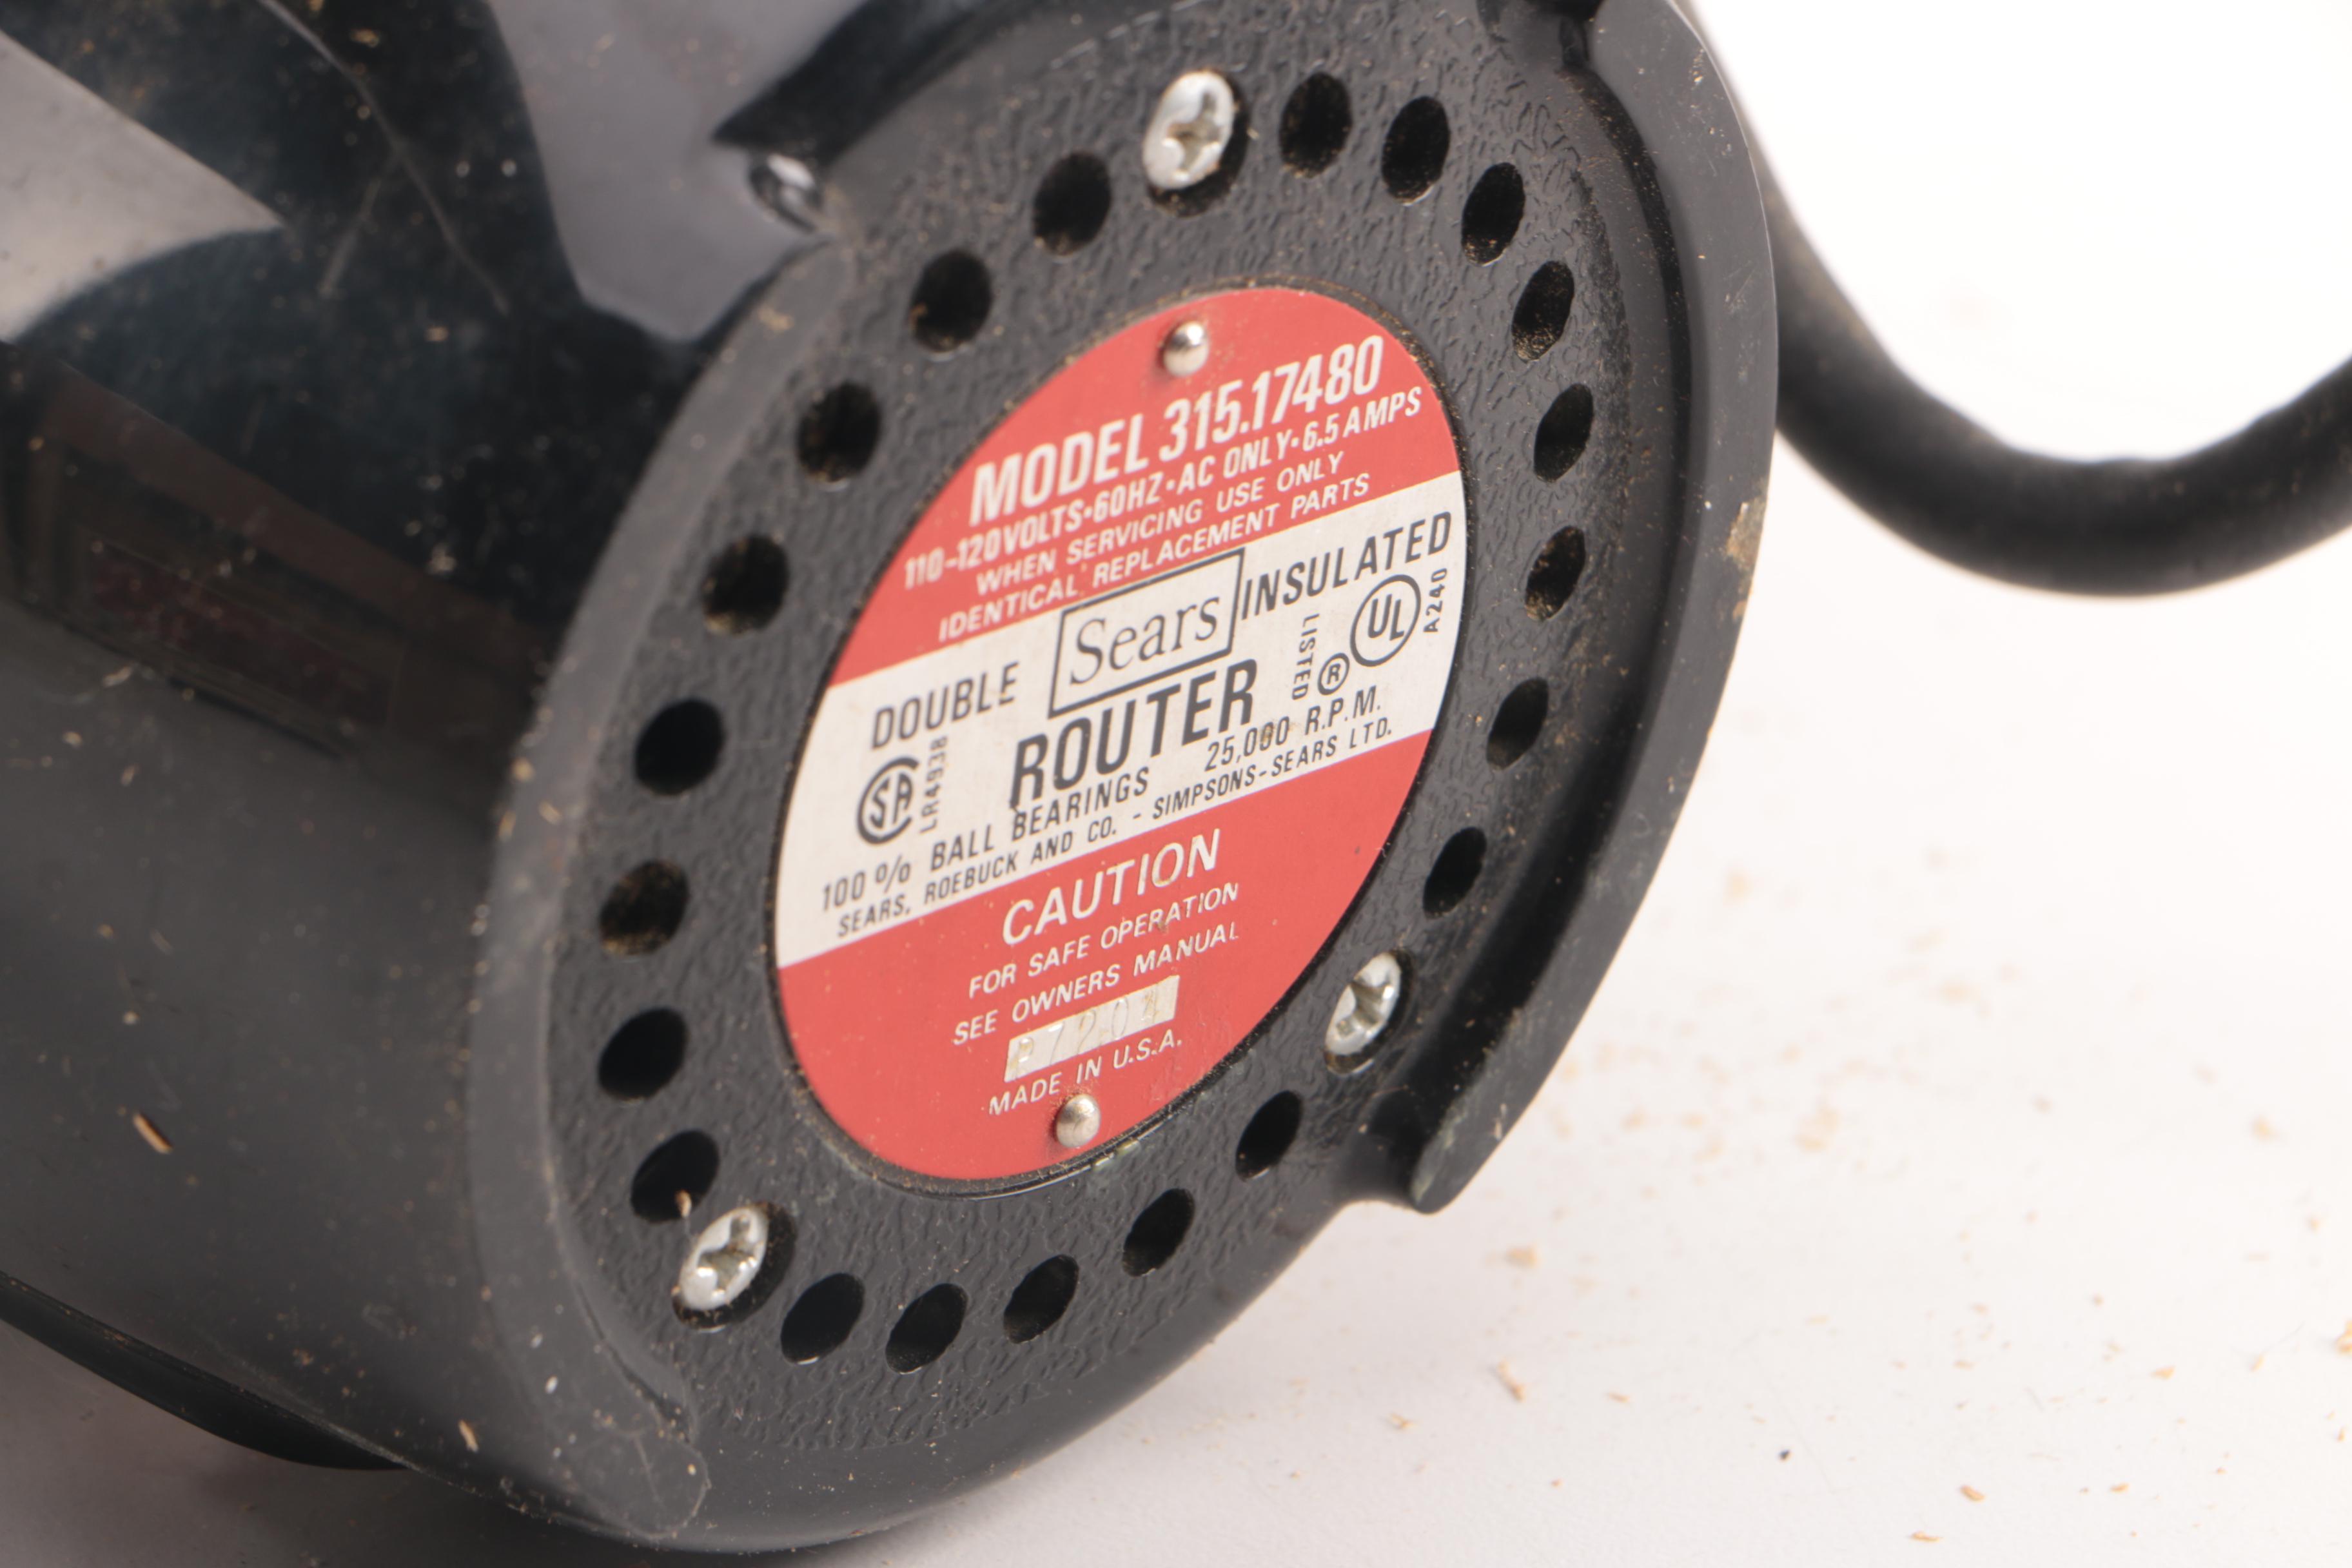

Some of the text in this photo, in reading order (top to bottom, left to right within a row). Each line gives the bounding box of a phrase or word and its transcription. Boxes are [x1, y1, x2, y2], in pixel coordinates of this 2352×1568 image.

[969, 335, 1384, 527] MODEL 315.17480
[939, 473, 1371, 642] IDENTICAL REPLACEMENT PARTS
[976, 451, 1344, 596] WHEN SERVICING USE ONLY
[1241, 511, 1451, 620] INSULATED
[1069, 596, 1219, 686] Sears
[1291, 613, 1319, 700] LISTED
[1424, 568, 1447, 633] A240
[870, 662, 1019, 749] DOUBLE
[1010, 659, 1257, 808] ROUTER
[1205, 685, 1380, 772] 25,000 R.P.M.
[838, 894, 910, 938] SEARS,
[924, 850, 1019, 911] ROEBUCK
[1032, 832, 1073, 865] AND
[1088, 814, 1117, 843] CO.
[1152, 734, 1337, 820] SIMPSONS-SEARS
[1350, 717, 1392, 749] LTD.
[930, 824, 994, 872] BALL
[1012, 766, 1150, 842] BEARINGS
[969, 883, 1239, 999] FOR SAFE OPERATION
[1003, 828, 1220, 945] CAUTION
[953, 922, 1239, 1046] SEE OWNERS MANUAL
[989, 1030, 1181, 1115] MADE IN U.S.A.
